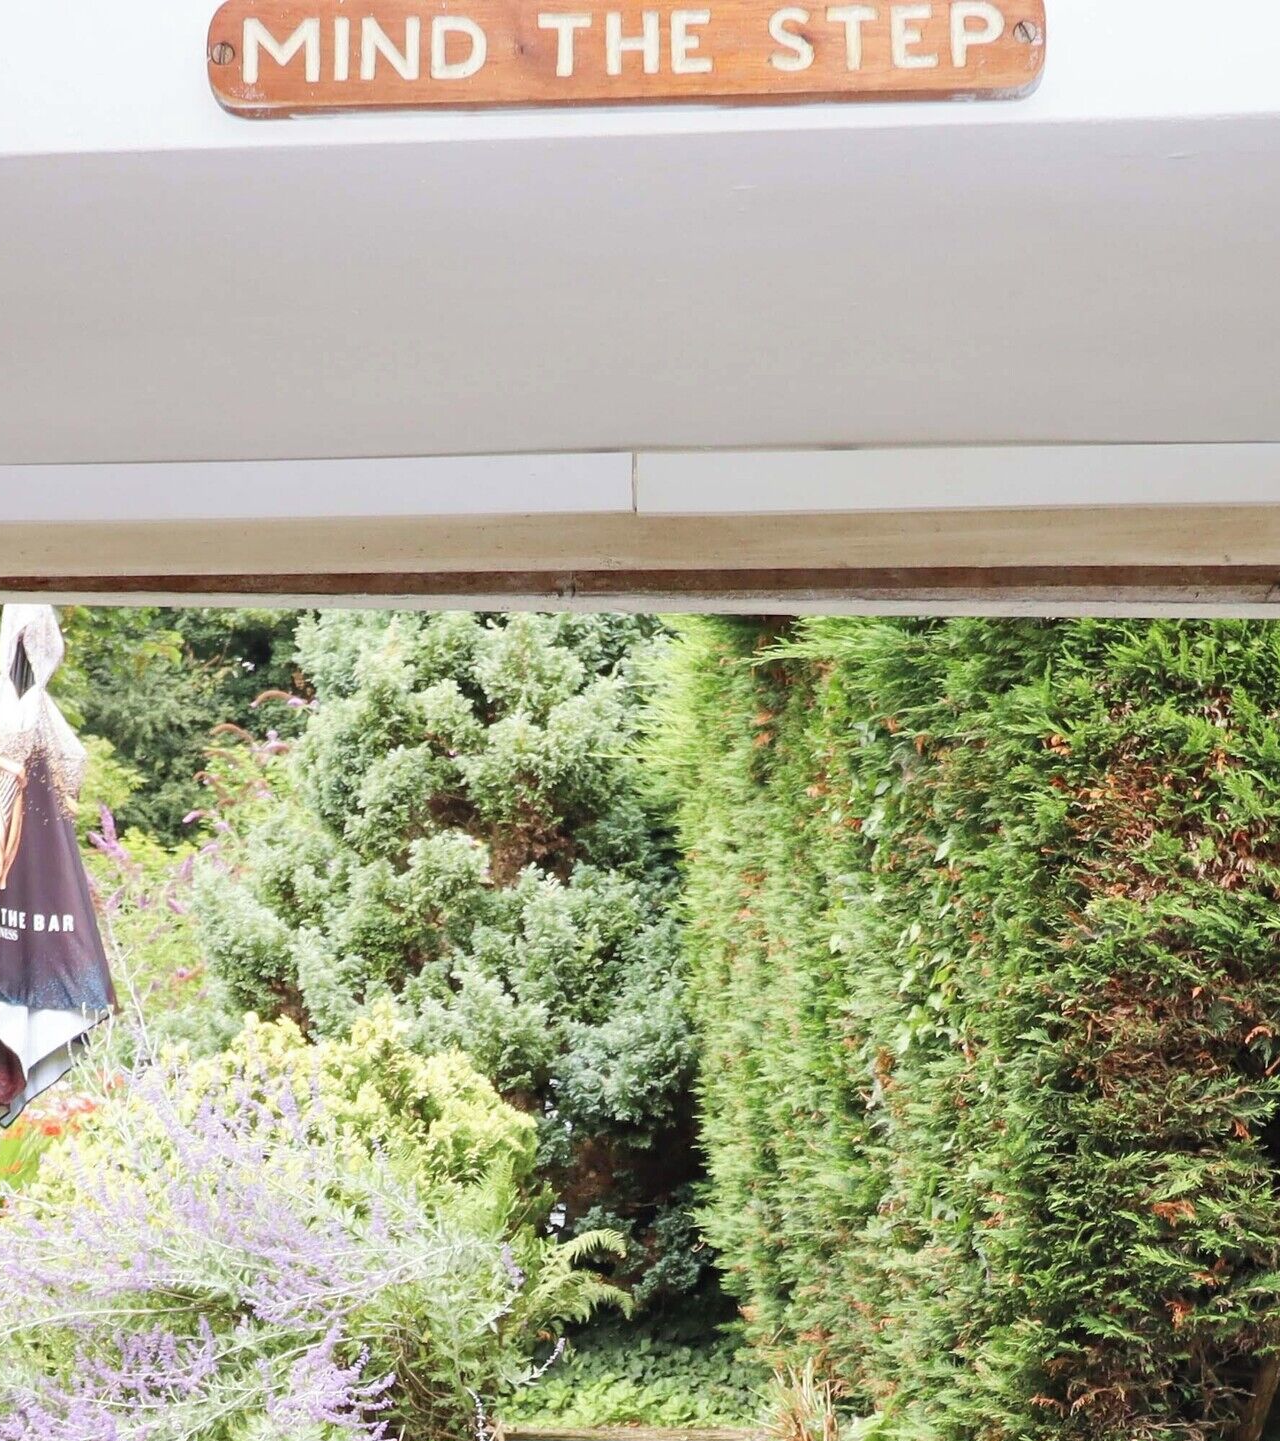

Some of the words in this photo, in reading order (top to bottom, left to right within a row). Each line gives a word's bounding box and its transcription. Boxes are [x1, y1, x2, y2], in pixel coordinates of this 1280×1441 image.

[242, 15, 487, 84] MIND
[537, 10, 713, 77] THE
[767, 1, 1005, 71] STEP
[1, 908, 26, 929] THE
[33, 914, 74, 932] BAR
